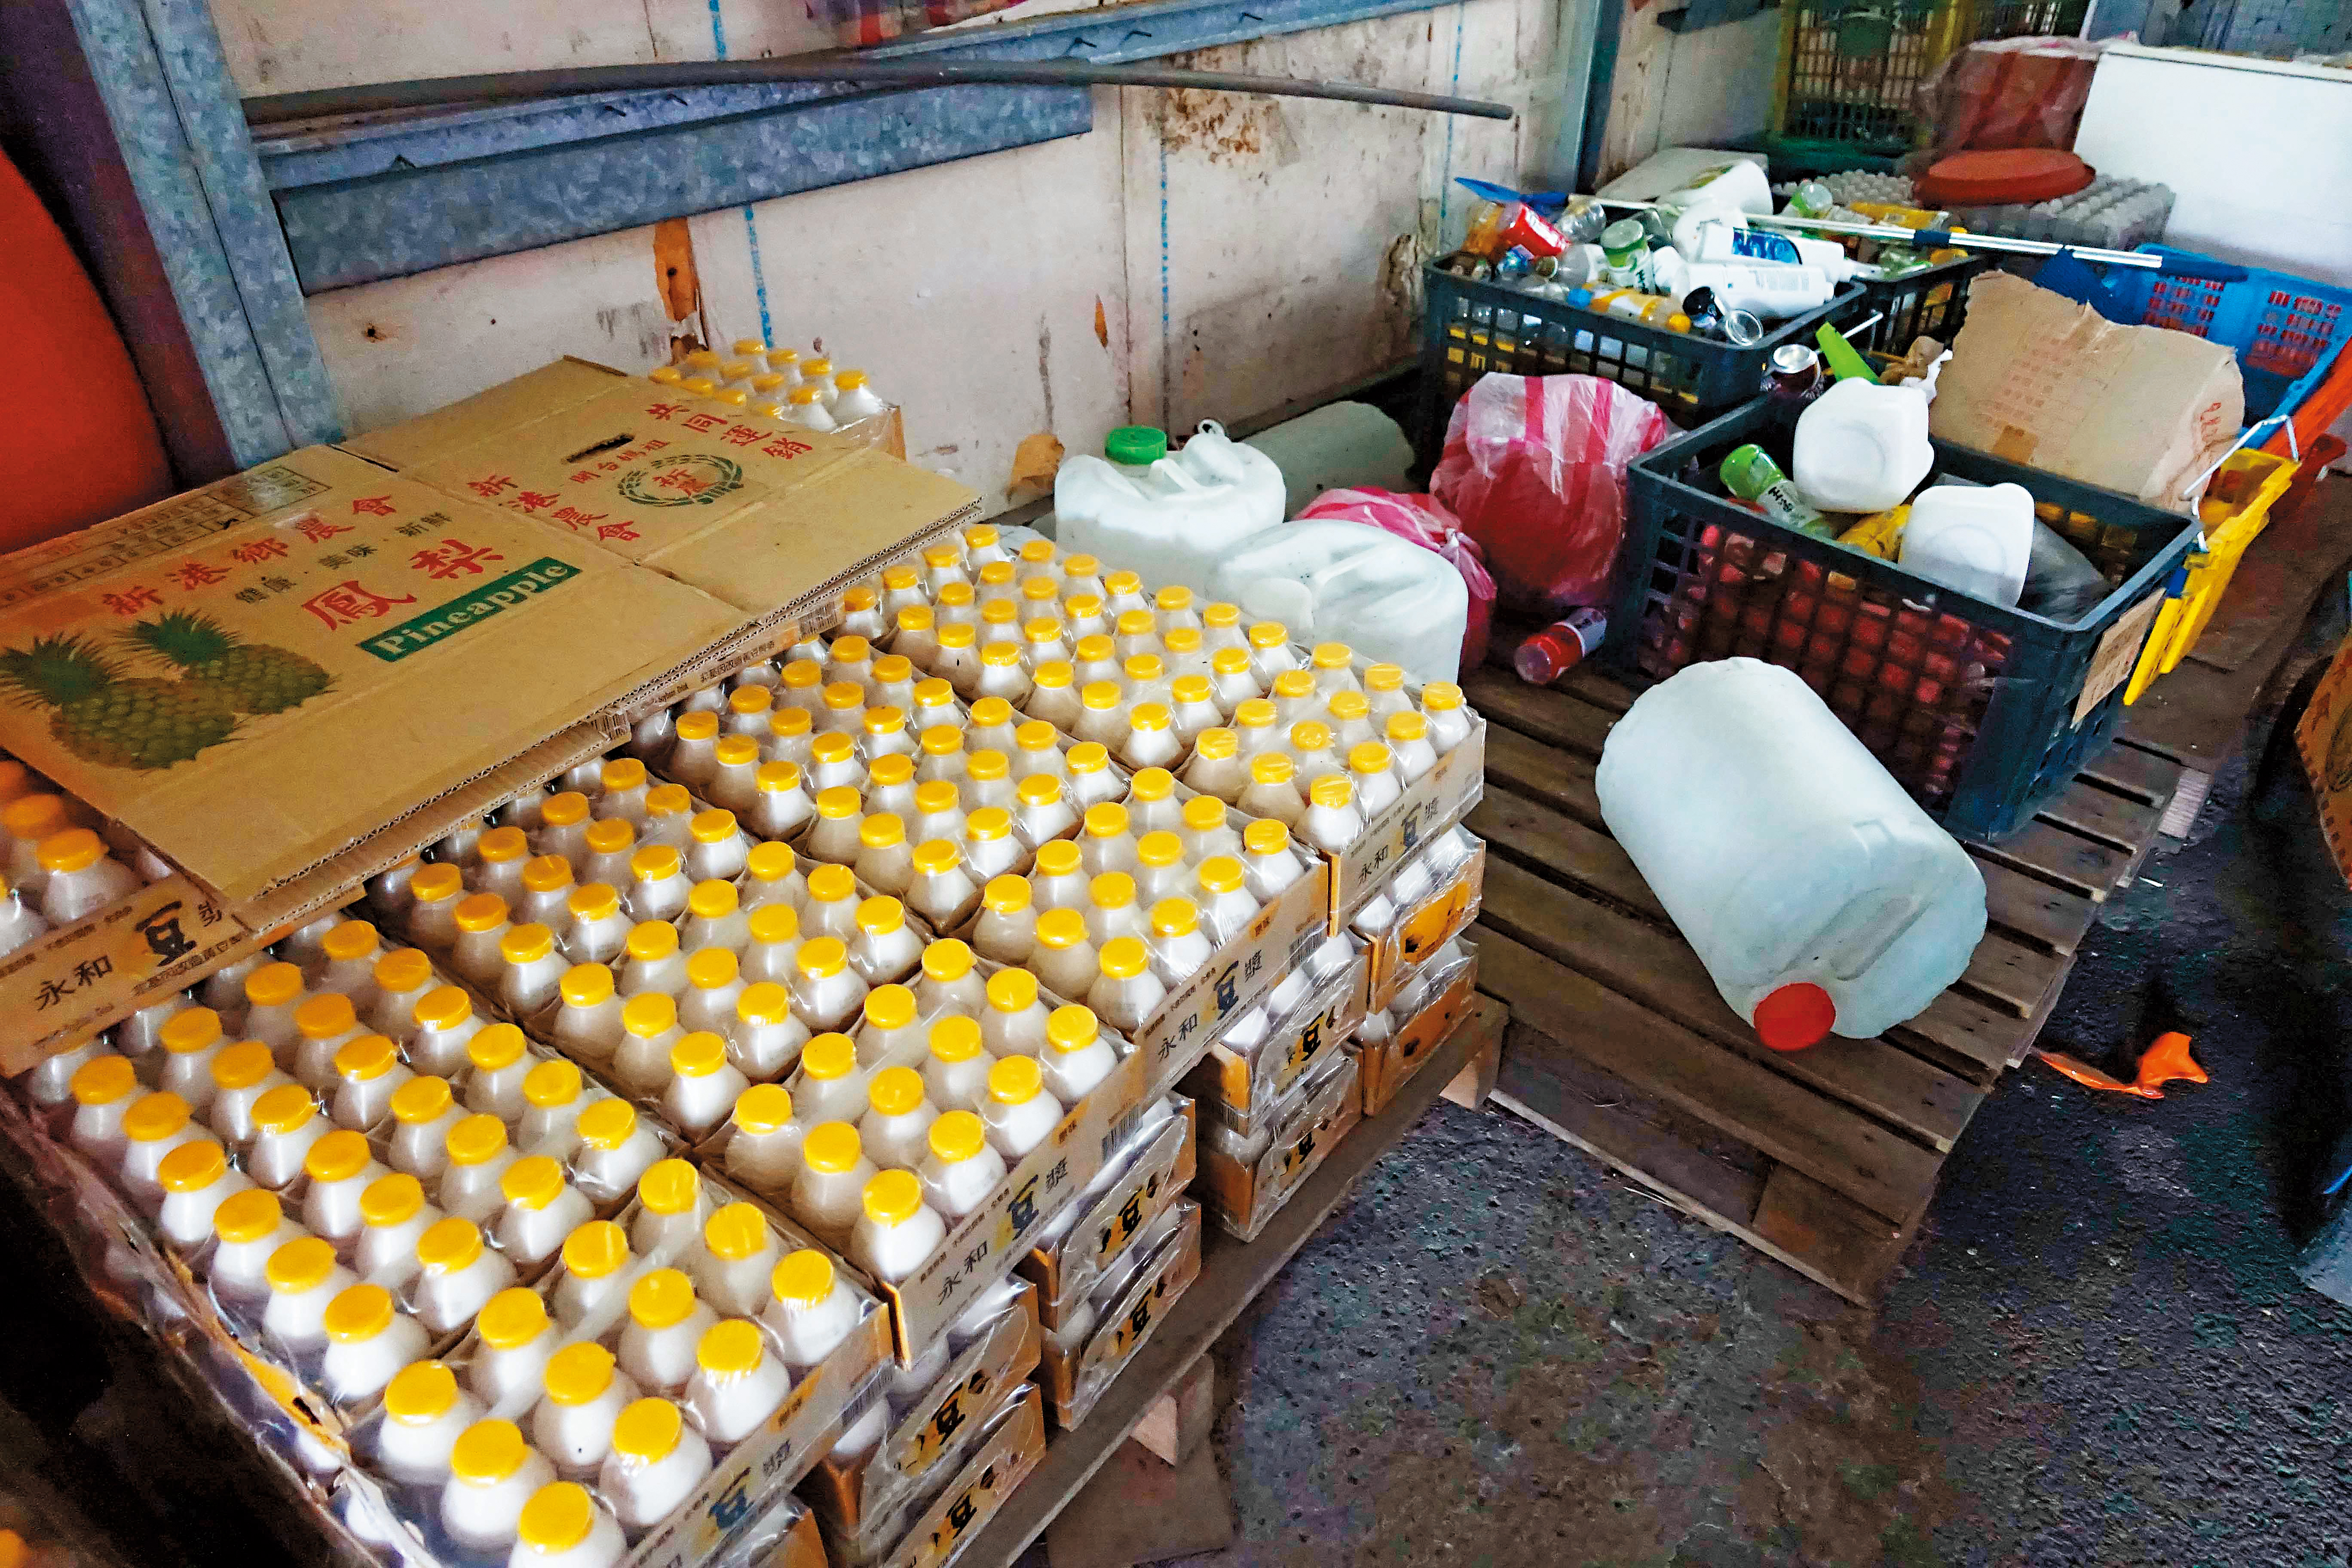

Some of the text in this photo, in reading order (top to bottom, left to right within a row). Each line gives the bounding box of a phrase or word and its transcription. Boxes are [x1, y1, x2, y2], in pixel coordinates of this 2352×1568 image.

[102, 495, 397, 616] 新港鄉農會
[467, 474, 640, 541] 新港農會
[302, 539, 504, 631] 鳳梨
[374, 562, 569, 654] Pineapple
[1158, 949, 1262, 1063] 永和豆漿
[938, 1155, 1068, 1305] 永和豆漿
